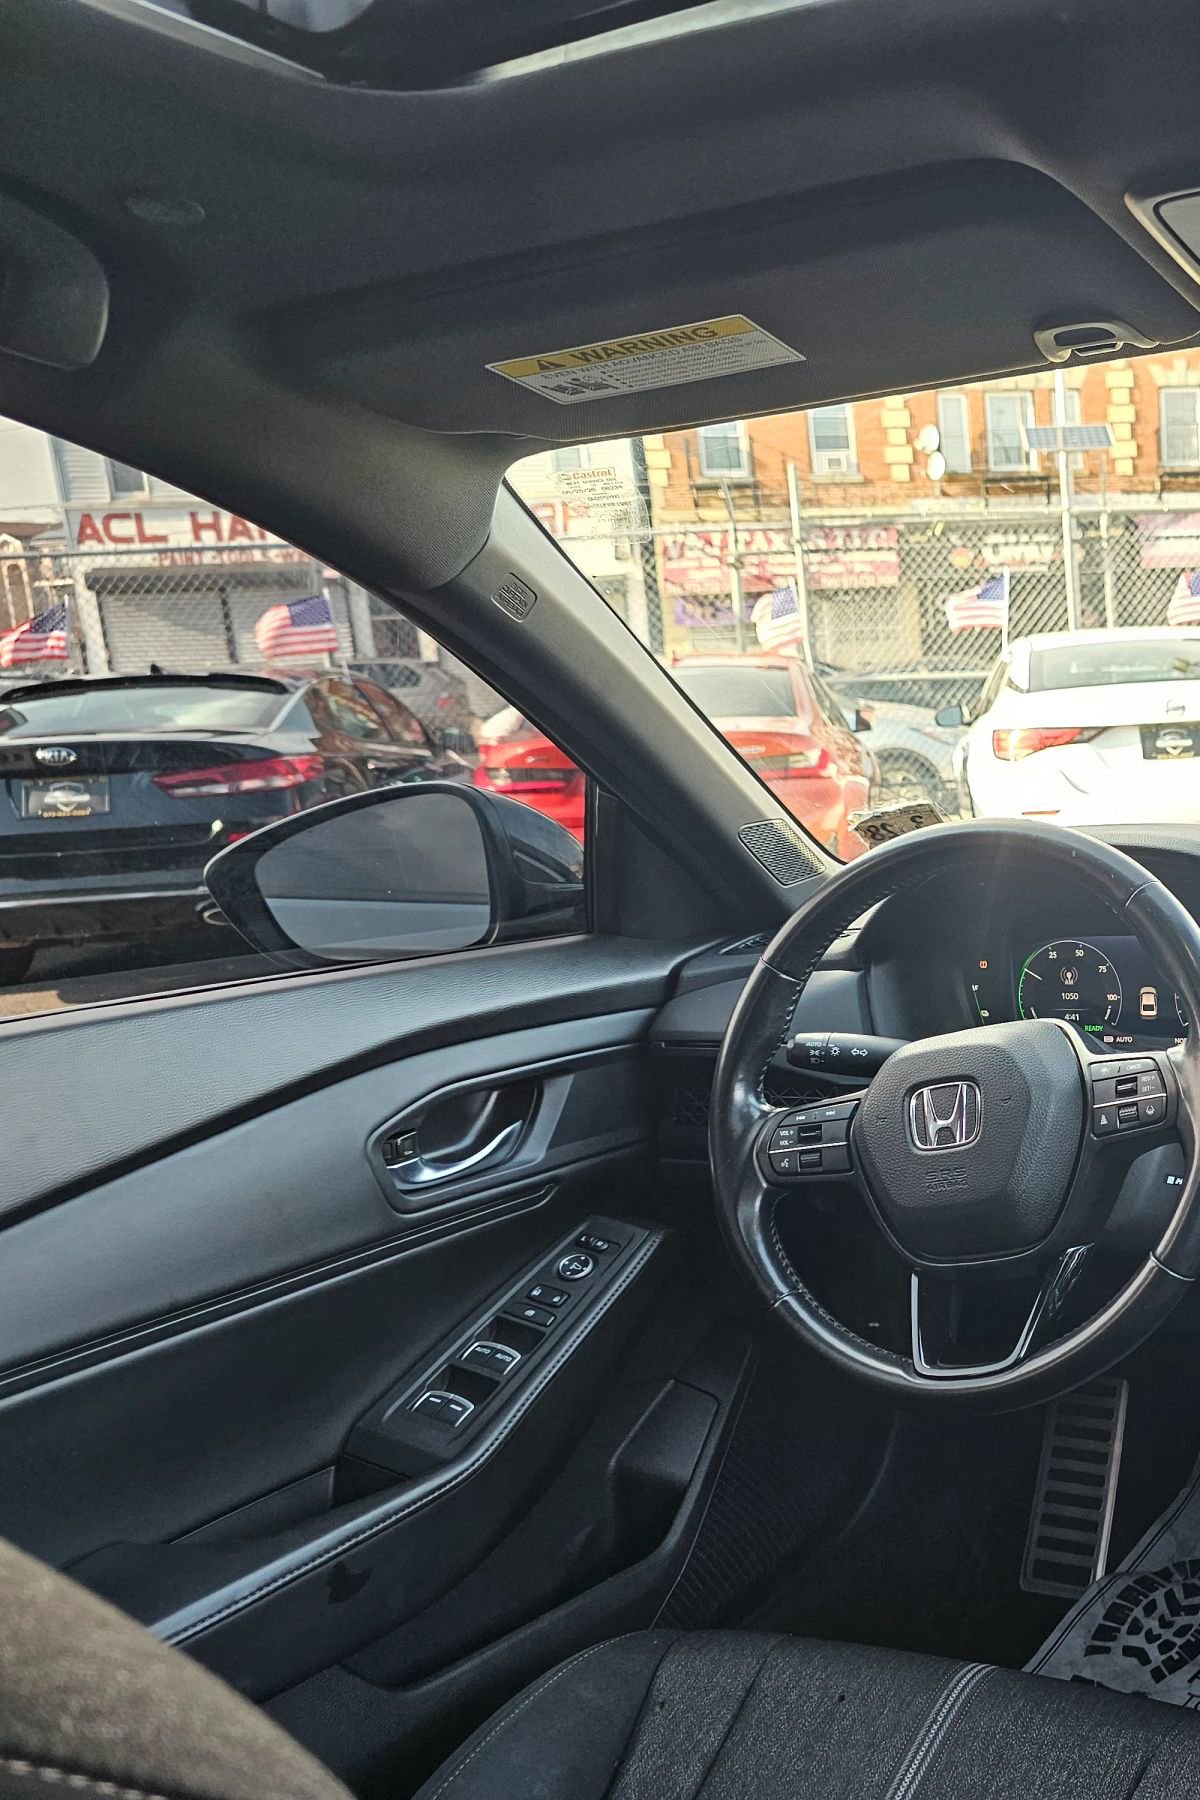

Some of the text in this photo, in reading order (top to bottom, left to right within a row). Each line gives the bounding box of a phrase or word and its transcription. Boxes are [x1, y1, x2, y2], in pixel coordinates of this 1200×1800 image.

[571, 326, 719, 364] WARNING
[609, 349, 681, 370] ADVANCED
[572, 468, 613, 480] Castrol
[77, 512, 169, 545] ACL
[44, 749, 70, 763] KIA
[1075, 949, 1084, 957] 50
[1061, 992, 1079, 1000] 1050
[1064, 1013, 1080, 1021] 4:41
[474, 1346, 491, 1355] AUTO
[494, 1352, 513, 1362] AUTO
